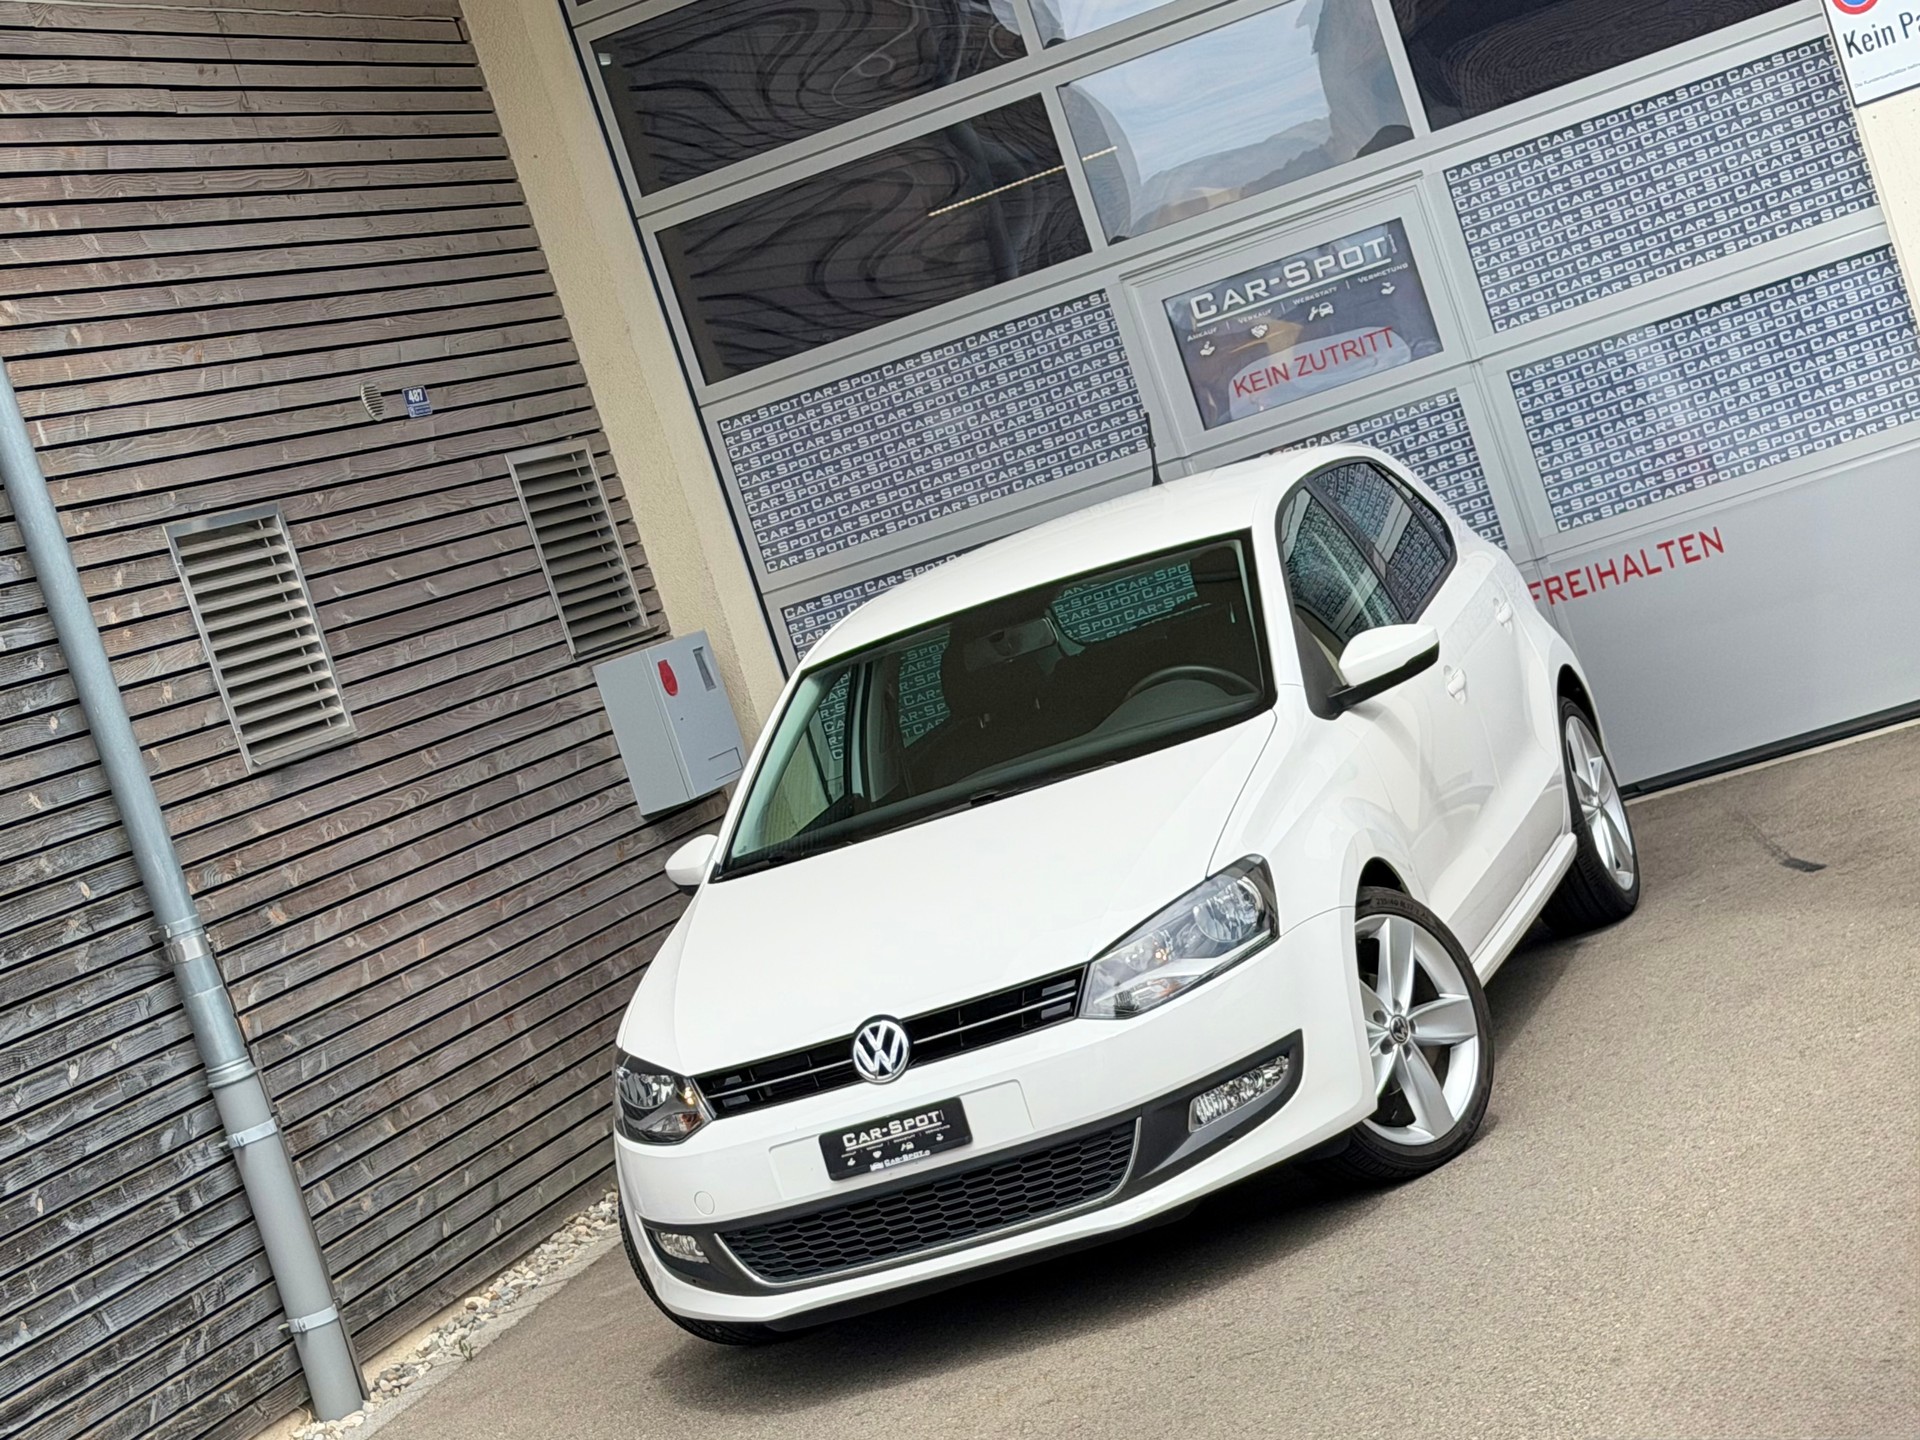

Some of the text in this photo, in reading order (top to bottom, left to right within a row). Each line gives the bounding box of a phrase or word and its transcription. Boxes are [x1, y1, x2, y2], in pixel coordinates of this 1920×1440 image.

[1843, 24, 1896, 58] Kein
[1445, 142, 1535, 183] CAR-SPOT
[1630, 75, 1724, 117] CAR-SPOT
[1725, 41, 1822, 84] CAR-SPOT
[1454, 171, 1545, 212] CAR-SPOT
[1545, 138, 1638, 180] CAR-SPOT
[1639, 105, 1734, 147] CAR-SPOT
[1734, 71, 1831, 114] CAR-SPOT
[1516, 66, 1800, 175] CAR-SPOT CAR-SPOT CAR-SPOT
[1463, 103, 1840, 242] CAR-SPOT CAR-SPOT CAR-SPOT CAR-SPOT
[1473, 133, 1849, 271] CAR-SPOT CAR-SPOT CAR-SPOT CAR-SPOT
[1525, 163, 1618, 204] CAR-SPOT
[1618, 130, 1712, 172] CAR-SPOT
[1535, 128, 1819, 235] CAR-SPOT CAR-SPOT CAR-SPOT
[1544, 158, 1828, 264] CAR-SPOT CAR-SPOT CAR-SPOT
[1190, 236, 1385, 319] CAR-SPOT
[1483, 165, 1859, 302] CAR-SPOT CAR-SPOT CAR-SPOT CAR-SPOT
[1493, 197, 1869, 332] CAR-SPOT CAR-SPOT CAR-SPOT CAR-SPOT
[1554, 190, 1838, 295] CAR-SPOT CAR-SPOT CAR-SPOT
[1233, 327, 1395, 398] KEIN ZUTRITT
[1508, 249, 1885, 383] CAR-SPOT CAR-SPOT CAR-SPOT CAR-SPOT
[1517, 279, 1894, 412] CAR-SPOT CAR-SPOT CAR-SPOT CAR-SPOT
[1579, 273, 1864, 376] CAR-SPOT CAR-SPOT CAR-SPOT
[1589, 303, 1873, 405] CAR-SPOT CAR-SPOT CAR-SPOT
[718, 311, 1048, 433] CAR-SPOT CAR-SPOT CAR-SPOT CAR-SPOT
[727, 339, 1057, 460] CAR-SPOT CAR-SPOT CAR-SPOT CAR-SPOT
[782, 391, 863, 427] CAR-SPOT
[863, 363, 945, 399] CAR-SPOT
[946, 334, 1030, 371] CAR-SPOT
[791, 419, 872, 454] CAR-SPOT
[872, 391, 955, 427] CAR-SPOT
[955, 362, 1039, 399] CAR-SPOT
[1527, 310, 1904, 442] CAR-SPOT CAR-SPOT CAR-SPOT CAR-SPOT
[1537, 341, 1914, 471] CAR-SPOT CAR-SPOT CAR-SPOT CAR-SPOT
[1598, 335, 1883, 436] CAR-SPOT CAR-SPOT CAR-SPOT
[1608, 365, 1893, 465] CAR-SPOT CAR-SPOT CAR-SPOT
[737, 369, 1066, 489] CAR-SPOT CAR-SPOT CAR-SPOT CAR-SPOT
[746, 398, 1076, 516] CAR-SPOT CAR-SPOT CAR-SPOT CAR-SPOT
[800, 448, 882, 483] CAR-SPOT
[882, 420, 964, 456] CAR-SPOT
[965, 392, 1048, 428] CAR-SPOT
[809, 475, 890, 511] CAR-SPOT
[891, 448, 973, 484] CAR-SPOT
[974, 420, 1057, 456] CAR-SPOT
[1546, 464, 1637, 501] CAR-SPOT
[1638, 434, 1731, 472] CAR-SPOT
[1732, 404, 1826, 443] CAR-SPOT
[1618, 397, 1903, 496] CAR-SPOT CAR-SPOT CAR-SPOT
[755, 428, 1085, 545] CAR-SPOT CAR-SPOT CAR-SPOT CAR-SPOT
[765, 458, 1095, 573] CAR-SPOT CAR-SPOT CAR-SPOT CAR-SPOT
[819, 505, 900, 540] CAR-SPOT
[900, 478, 982, 513] CAR-SPOT
[983, 450, 1067, 486] CAR-SPOT
[1556, 495, 1647, 532] CAR-SPOT
[1648, 465, 1741, 503] CAR-SPOT
[1742, 436, 1837, 474] CAR-SPOT
[784, 585, 864, 619] CAR-SPOT
[842, 1111, 939, 1148] CAR-SPOT
